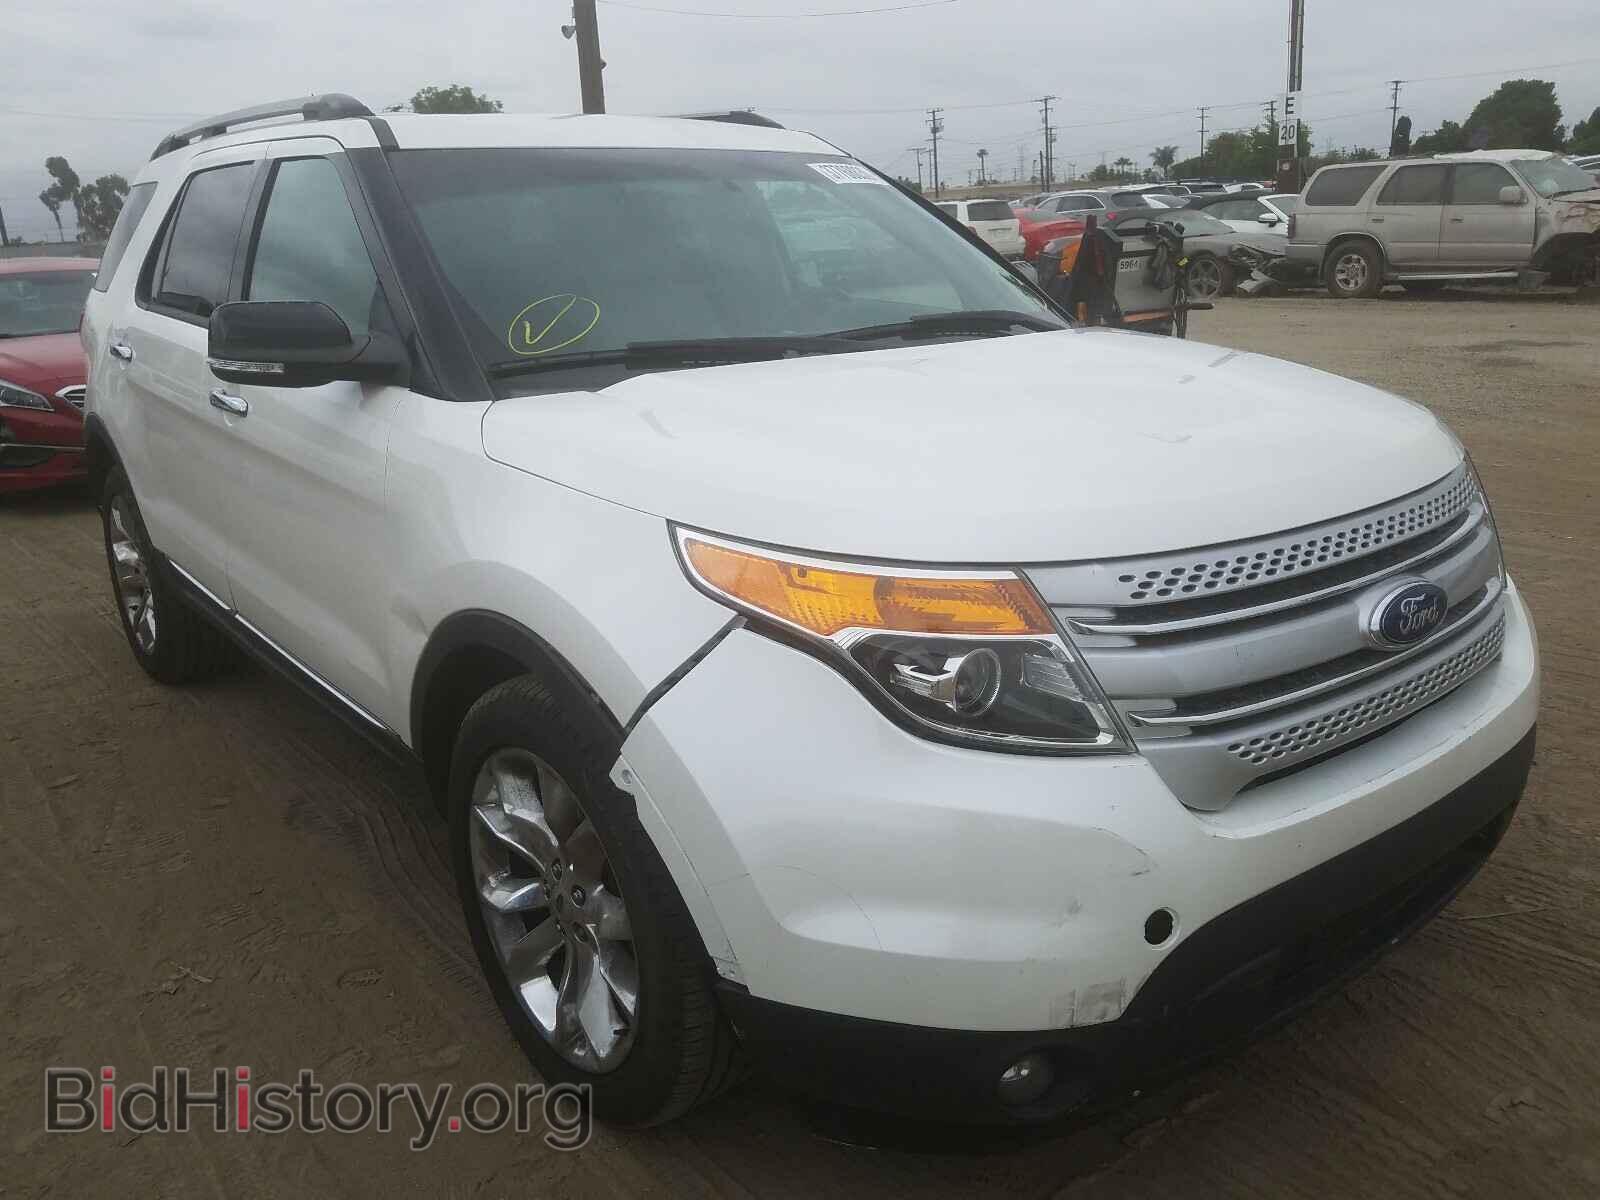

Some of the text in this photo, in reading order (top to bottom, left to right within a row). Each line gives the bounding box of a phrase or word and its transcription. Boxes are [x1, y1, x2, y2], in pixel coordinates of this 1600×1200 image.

[1285, 97, 1295, 115] E
[1280, 125, 1295, 140] 20
[1400, 593, 1440, 635] Ford
